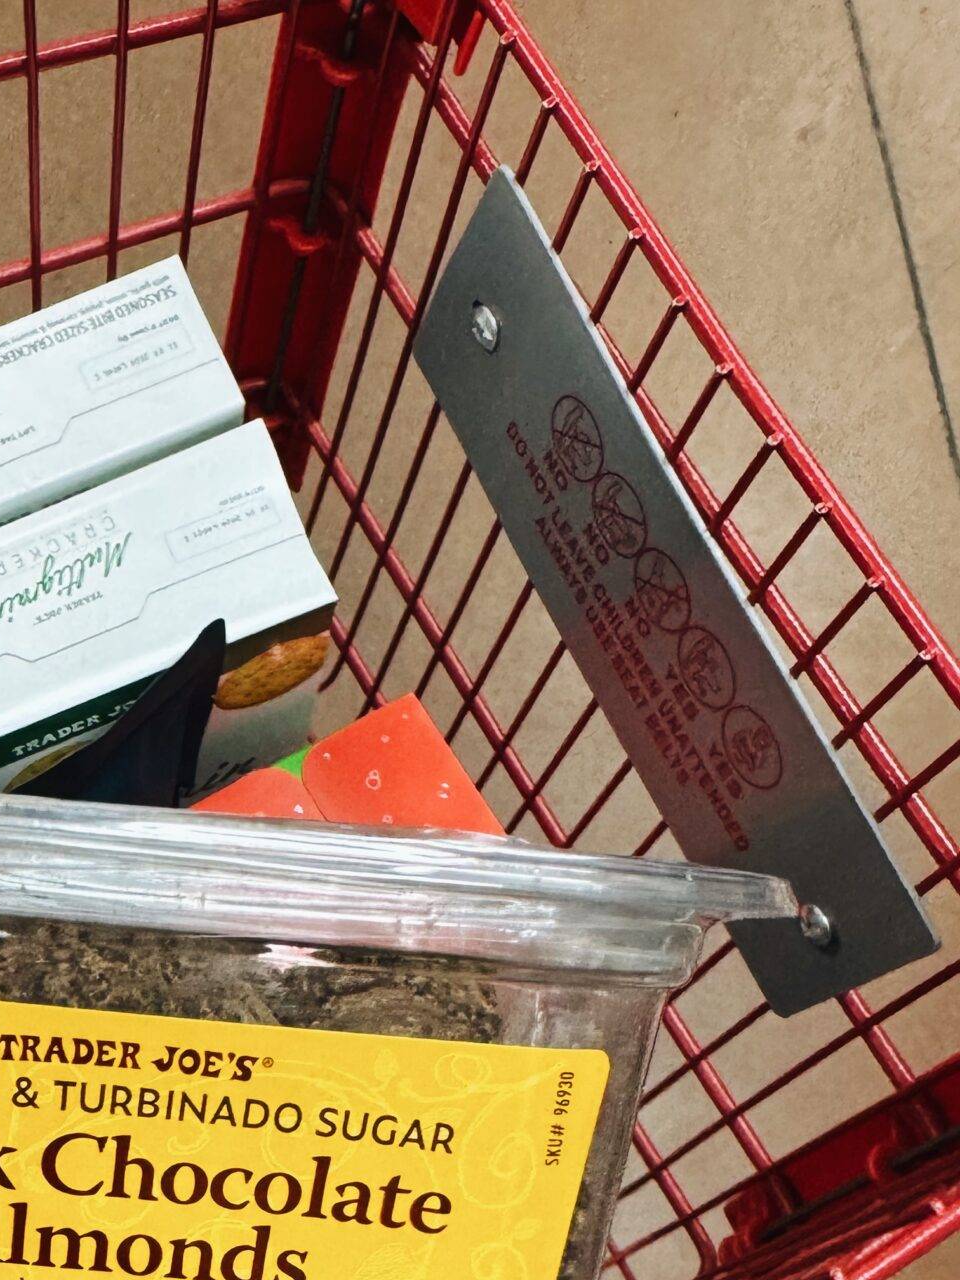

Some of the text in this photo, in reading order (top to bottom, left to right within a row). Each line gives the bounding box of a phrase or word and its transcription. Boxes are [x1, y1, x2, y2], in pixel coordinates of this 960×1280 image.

[113, 284, 177, 319] SEASONED
[535, 514, 589, 605] ALWAYS
[525, 458, 554, 505] NOT
[548, 505, 595, 584] LEAVE
[595, 587, 663, 698] CHILDREN
[658, 697, 751, 854] UNATTENDED
[663, 662, 699, 722] YES
[12, 715, 100, 756] TRADER
[11, 1076, 40, 1109] &
[53, 1079, 303, 1134] TURBINADO
[315, 1107, 455, 1154] SUGAR
[545, 1071, 576, 1166] SKU# 96930
[40, 1132, 452, 1235] Chocolate
